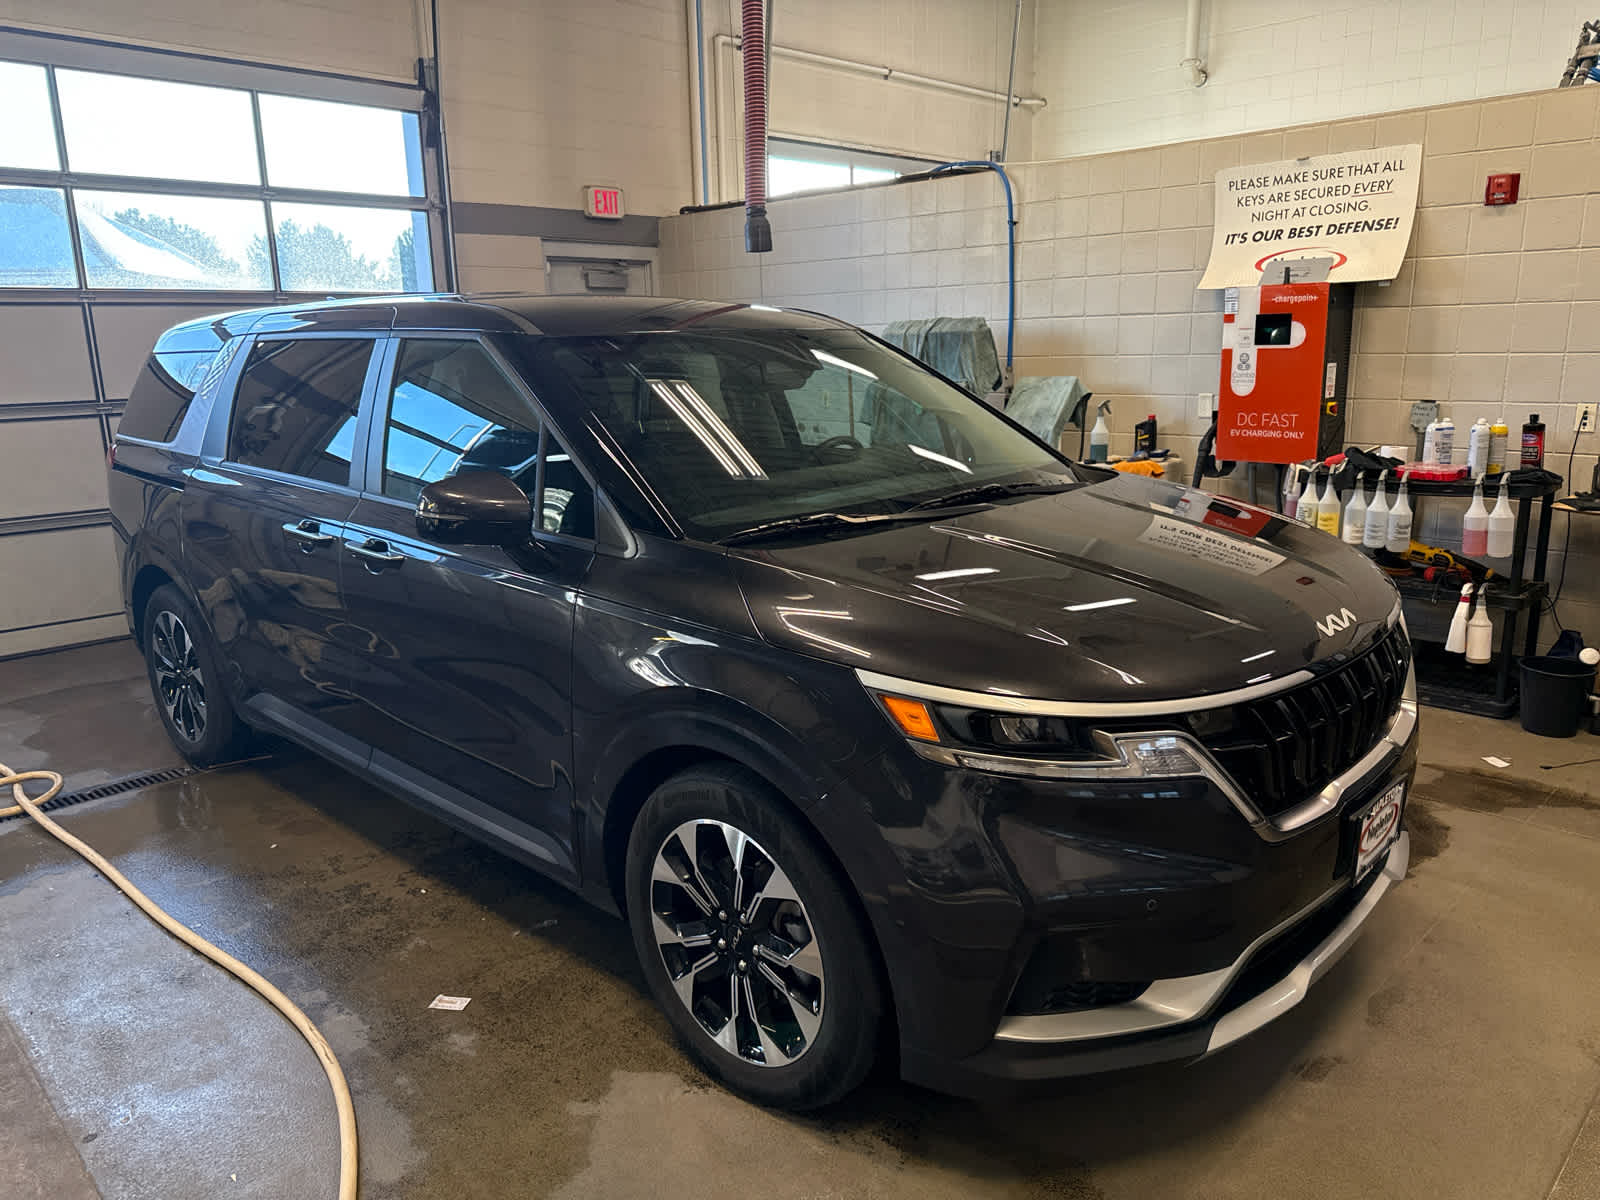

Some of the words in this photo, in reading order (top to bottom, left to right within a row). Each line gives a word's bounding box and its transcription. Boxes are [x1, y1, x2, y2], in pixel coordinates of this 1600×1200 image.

[1228, 176, 1270, 192] PLEASE
[1273, 171, 1309, 187] MAKE
[1312, 166, 1345, 182] SURE
[1347, 162, 1380, 177] THAT
[1382, 159, 1405, 173] ALL
[594, 189, 618, 216] EXIT
[1237, 194, 1265, 208] KEYS
[1267, 191, 1291, 205] ARE
[1294, 184, 1351, 201] SECURED
[1353, 179, 1394, 195] EVERY
[1251, 208, 1290, 223] NIGHT
[1292, 206, 1307, 219] AT
[1309, 200, 1372, 217] CLOSING.
[1225, 232, 1248, 245] IT'S
[1252, 229, 1284, 243] OUR
[1287, 225, 1323, 239] BEST
[1326, 217, 1400, 236] DEFENSE!
[1237, 412, 1258, 426] DC
[1261, 413, 1299, 428] FAST
[1241, 429, 1282, 438] CHARGING
[1283, 431, 1304, 439] ONLY
